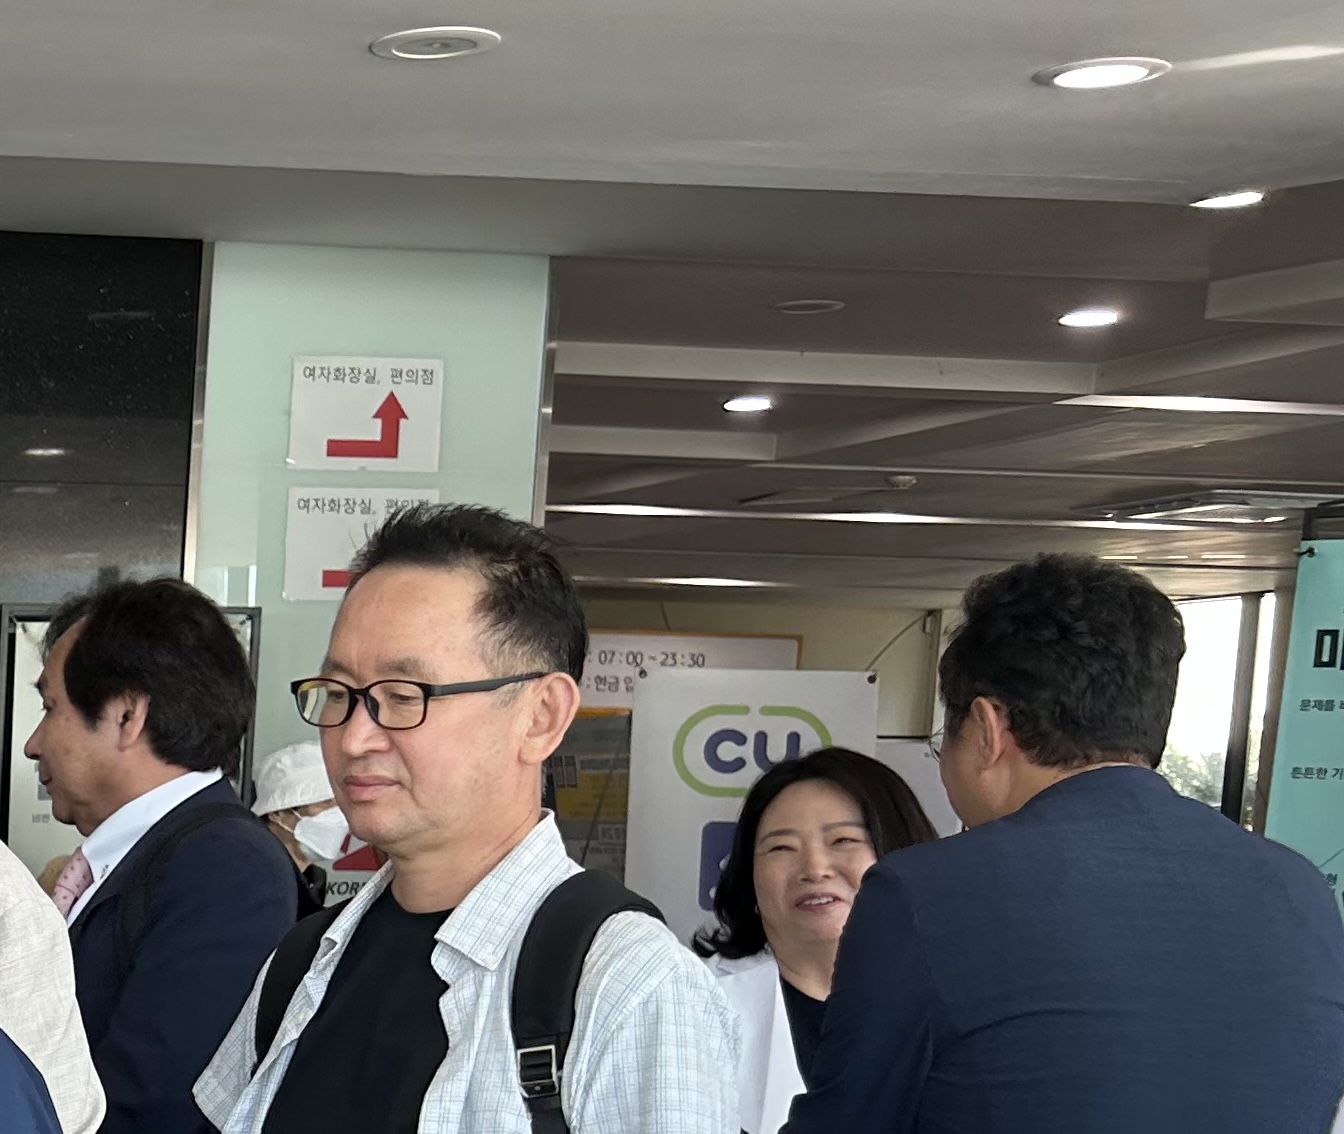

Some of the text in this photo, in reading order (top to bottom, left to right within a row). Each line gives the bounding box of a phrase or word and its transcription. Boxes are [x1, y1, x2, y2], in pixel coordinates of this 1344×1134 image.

[390, 367, 434, 385] 편의점
[1299, 698, 1336, 712] 문제를
[1291, 766, 1328, 780] 튼튼한
[326, 880, 368, 896] KOR
